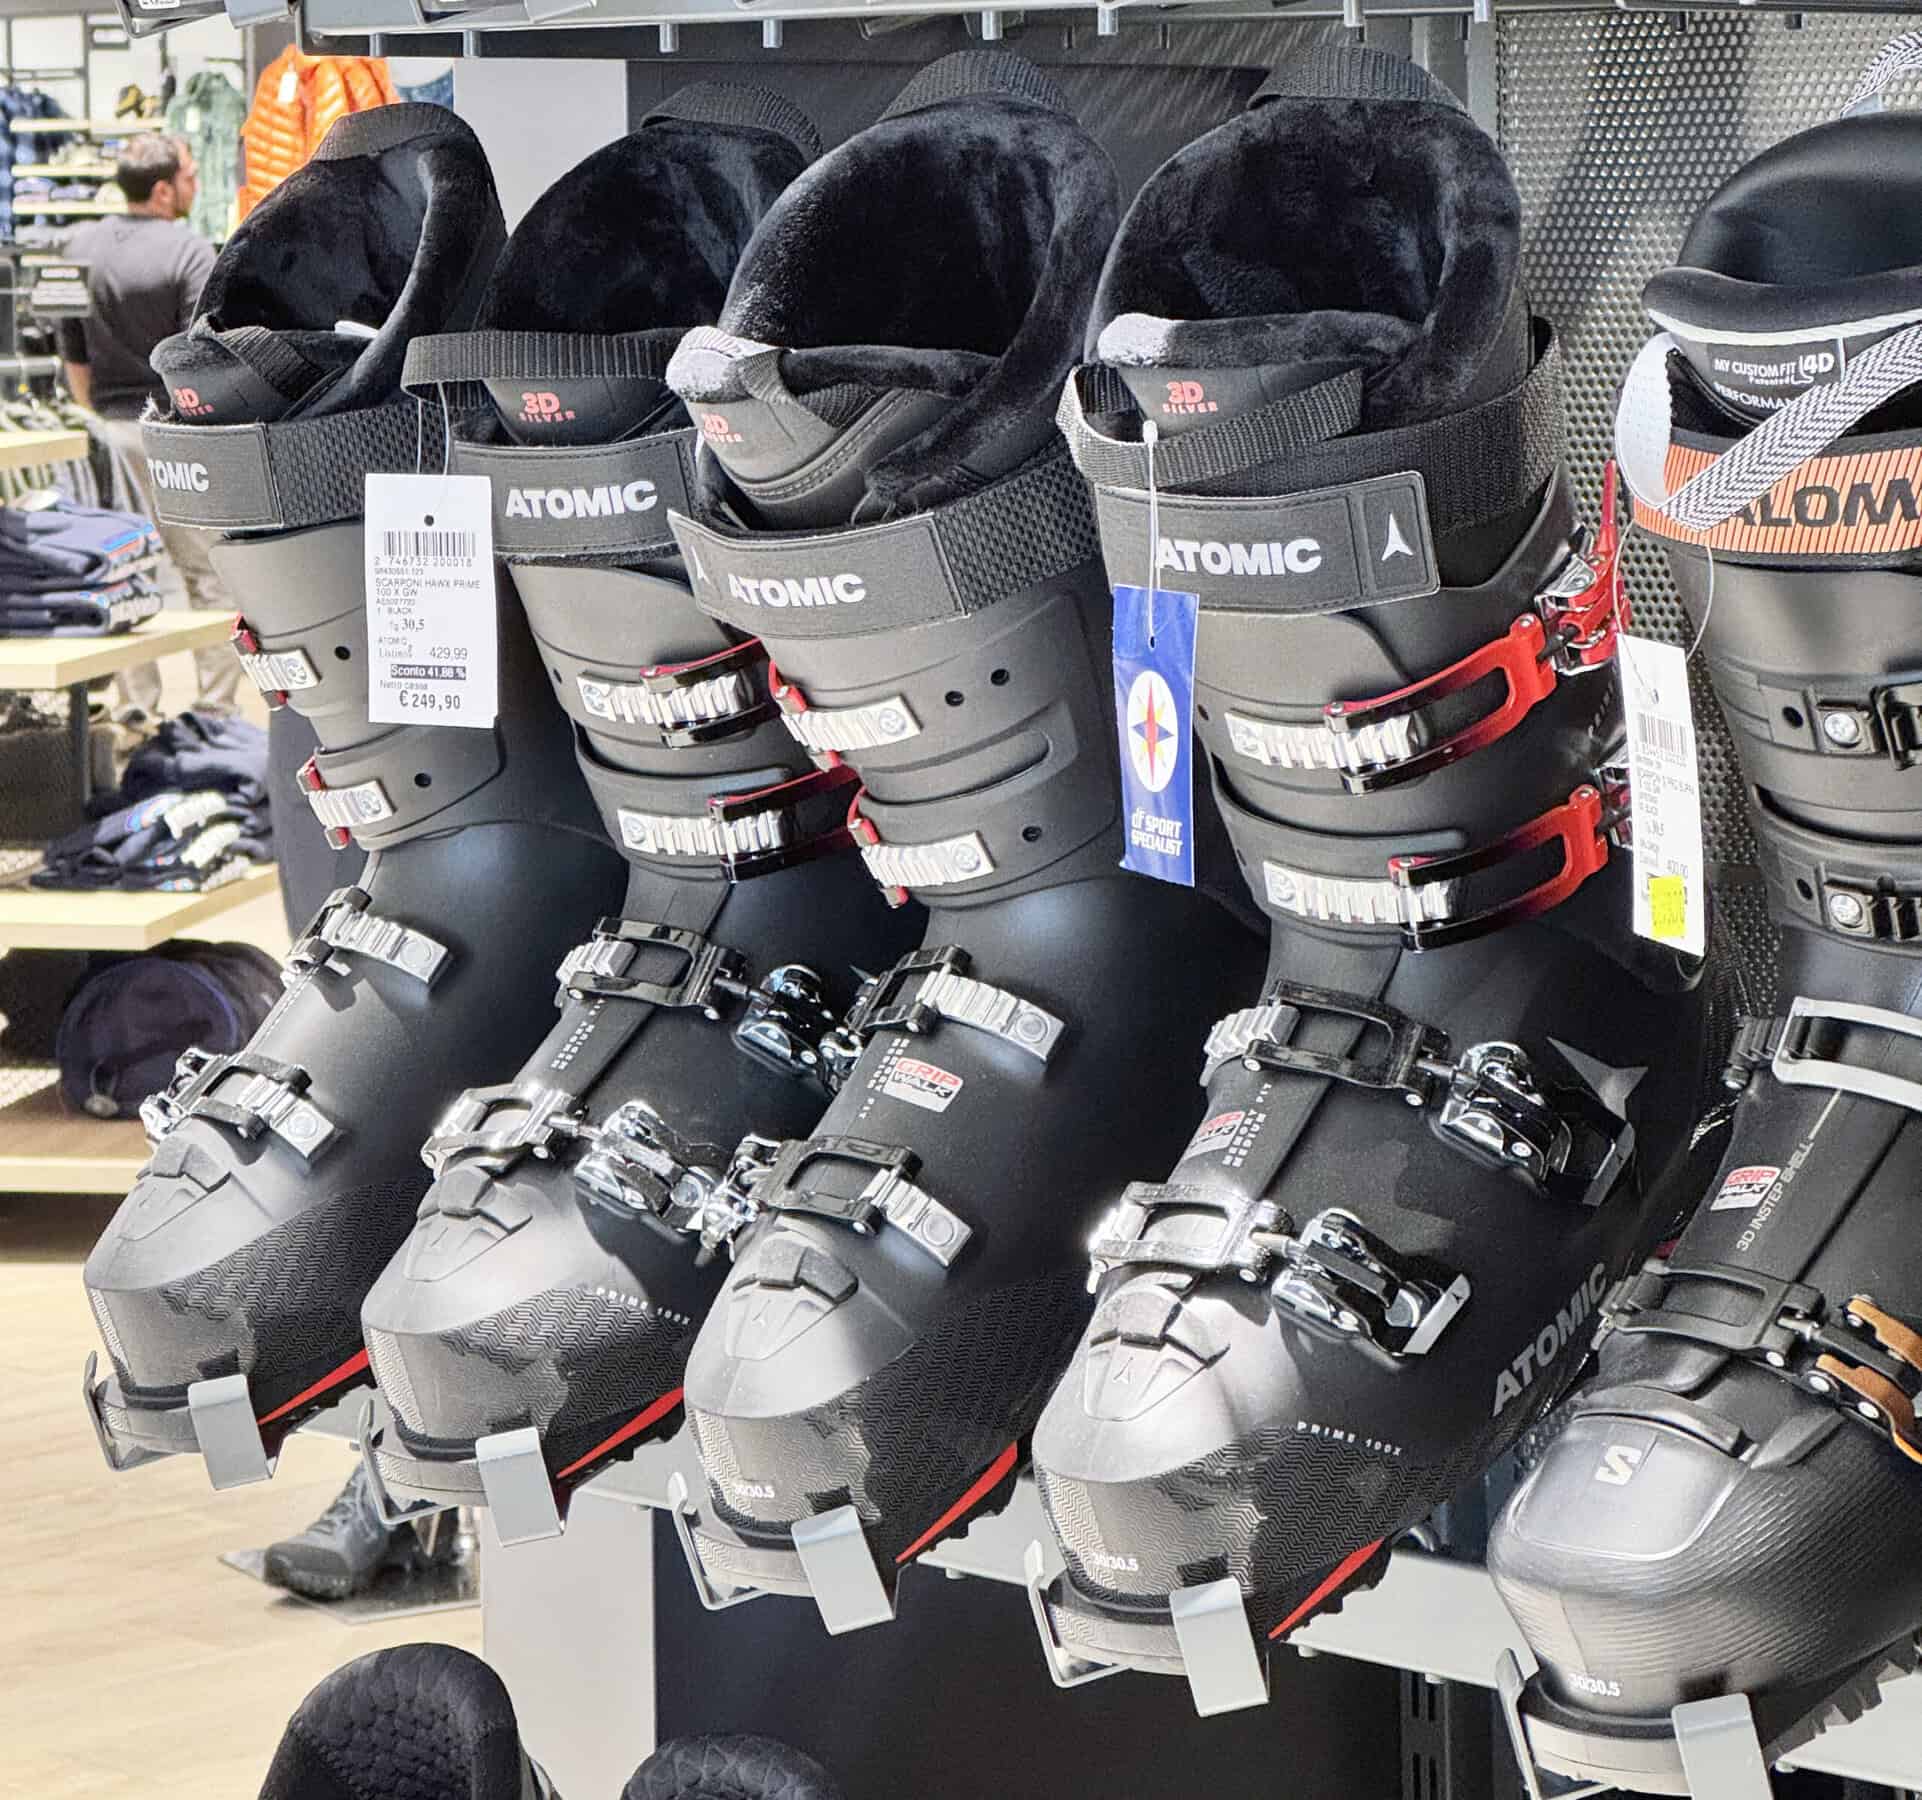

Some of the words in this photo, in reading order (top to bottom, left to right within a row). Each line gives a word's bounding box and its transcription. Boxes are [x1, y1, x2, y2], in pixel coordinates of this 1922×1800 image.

[1714, 358, 1730, 372] MY
[521, 390, 561, 415] 3D
[1166, 380, 1204, 405] 3D
[519, 409, 577, 425] SILVER
[1162, 400, 1219, 414] SILVER
[505, 480, 659, 520] ATOMIC
[1156, 537, 1323, 576] ATOMIC
[376, 577, 422, 588] SCARPONI
[454, 579, 481, 590] PRIME
[376, 587, 392, 597] 100
[727, 572, 867, 608] ATOMIC
[391, 664, 427, 677] Sconto
[1144, 814, 1183, 839] SPORT
[1736, 1230, 1756, 1252] 3D
[1749, 1182, 1784, 1231] INSTEP
[1493, 1262, 1607, 1417] ATOMIC
[1297, 1420, 1356, 1444] PRIME
